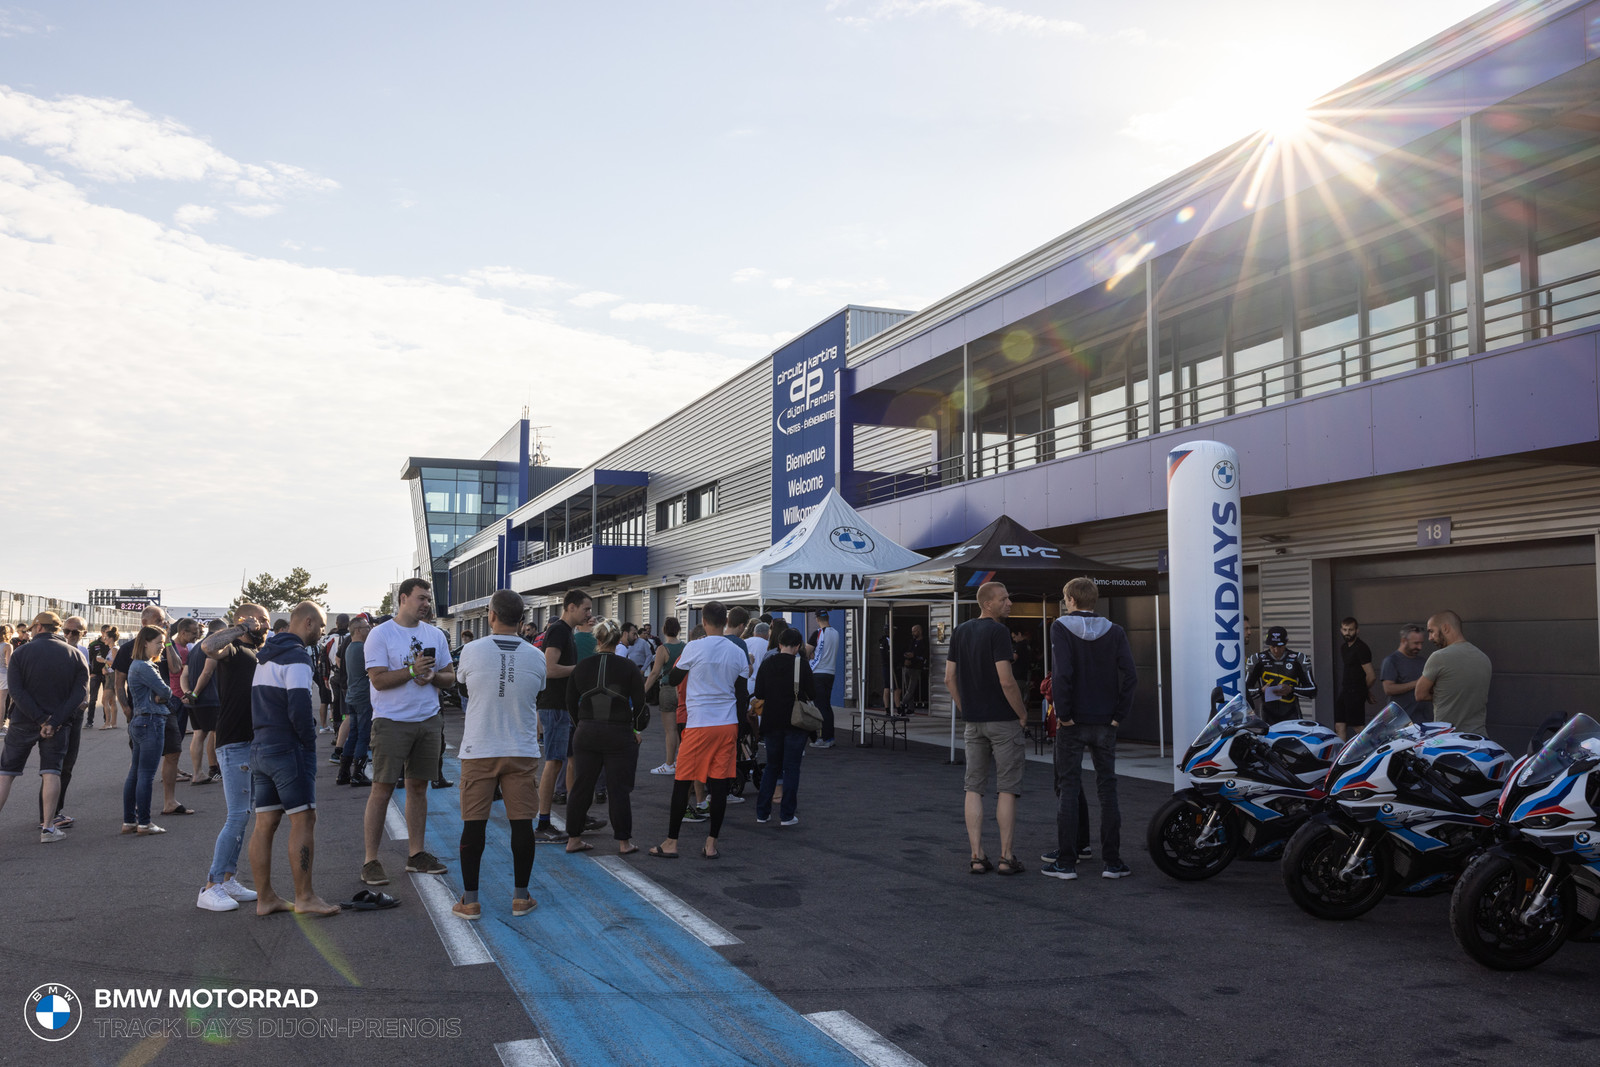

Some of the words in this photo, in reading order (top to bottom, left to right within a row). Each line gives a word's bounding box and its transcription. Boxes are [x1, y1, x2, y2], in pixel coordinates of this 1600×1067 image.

[777, 362, 802, 385] circuit
[808, 346, 837, 369] karting
[787, 403, 805, 418] dijon
[786, 445, 826, 472] Bienvenue
[788, 474, 824, 498] Welcome
[1425, 524, 1442, 539] 18
[1000, 545, 1061, 558] BMC
[694, 579, 710, 595] BMW
[711, 573, 751, 594] MOTORRAD
[789, 572, 844, 590] BMW
[851, 573, 865, 590] M
[1093, 577, 1147, 587] bmc-moto.com
[120, 602, 146, 610] 8:27:21
[192, 608, 199, 618] 3
[508, 654, 516, 667] Days
[498, 681, 506, 697] BMW
